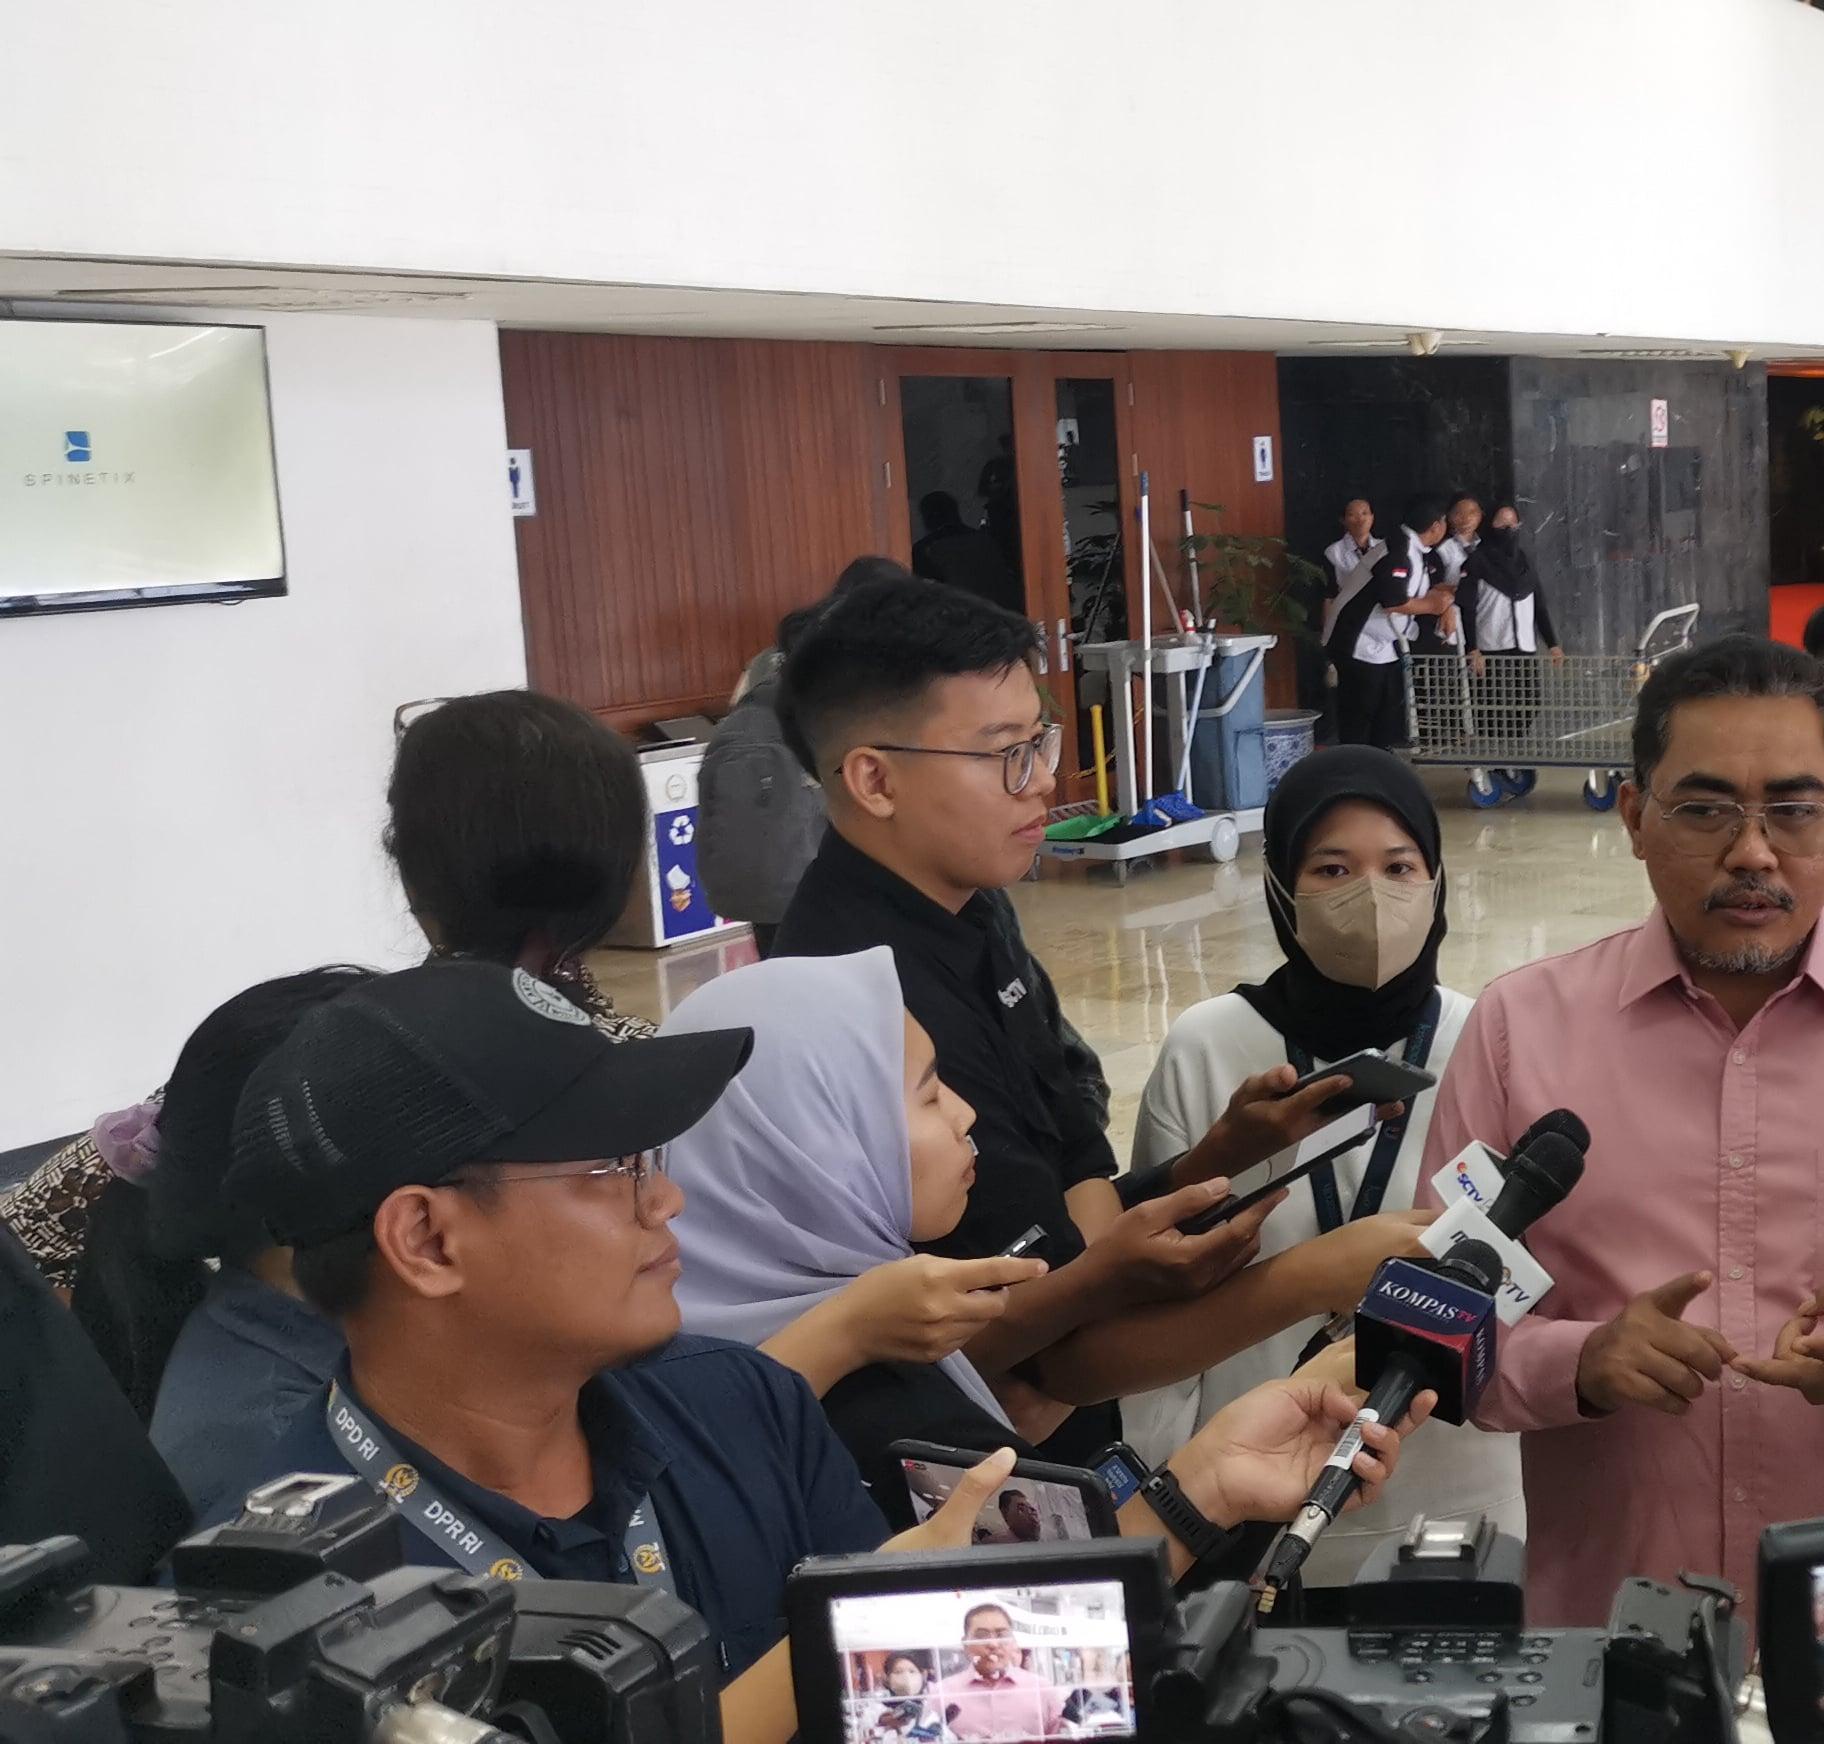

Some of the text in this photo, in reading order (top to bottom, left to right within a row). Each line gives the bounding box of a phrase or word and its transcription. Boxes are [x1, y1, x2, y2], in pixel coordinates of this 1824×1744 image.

[1457, 1171, 1484, 1203] SCTV
[1378, 1280, 1460, 1322] KOMPAS
[335, 1407, 381, 1461] DPD RI
[424, 1500, 483, 1555] DPR RI
